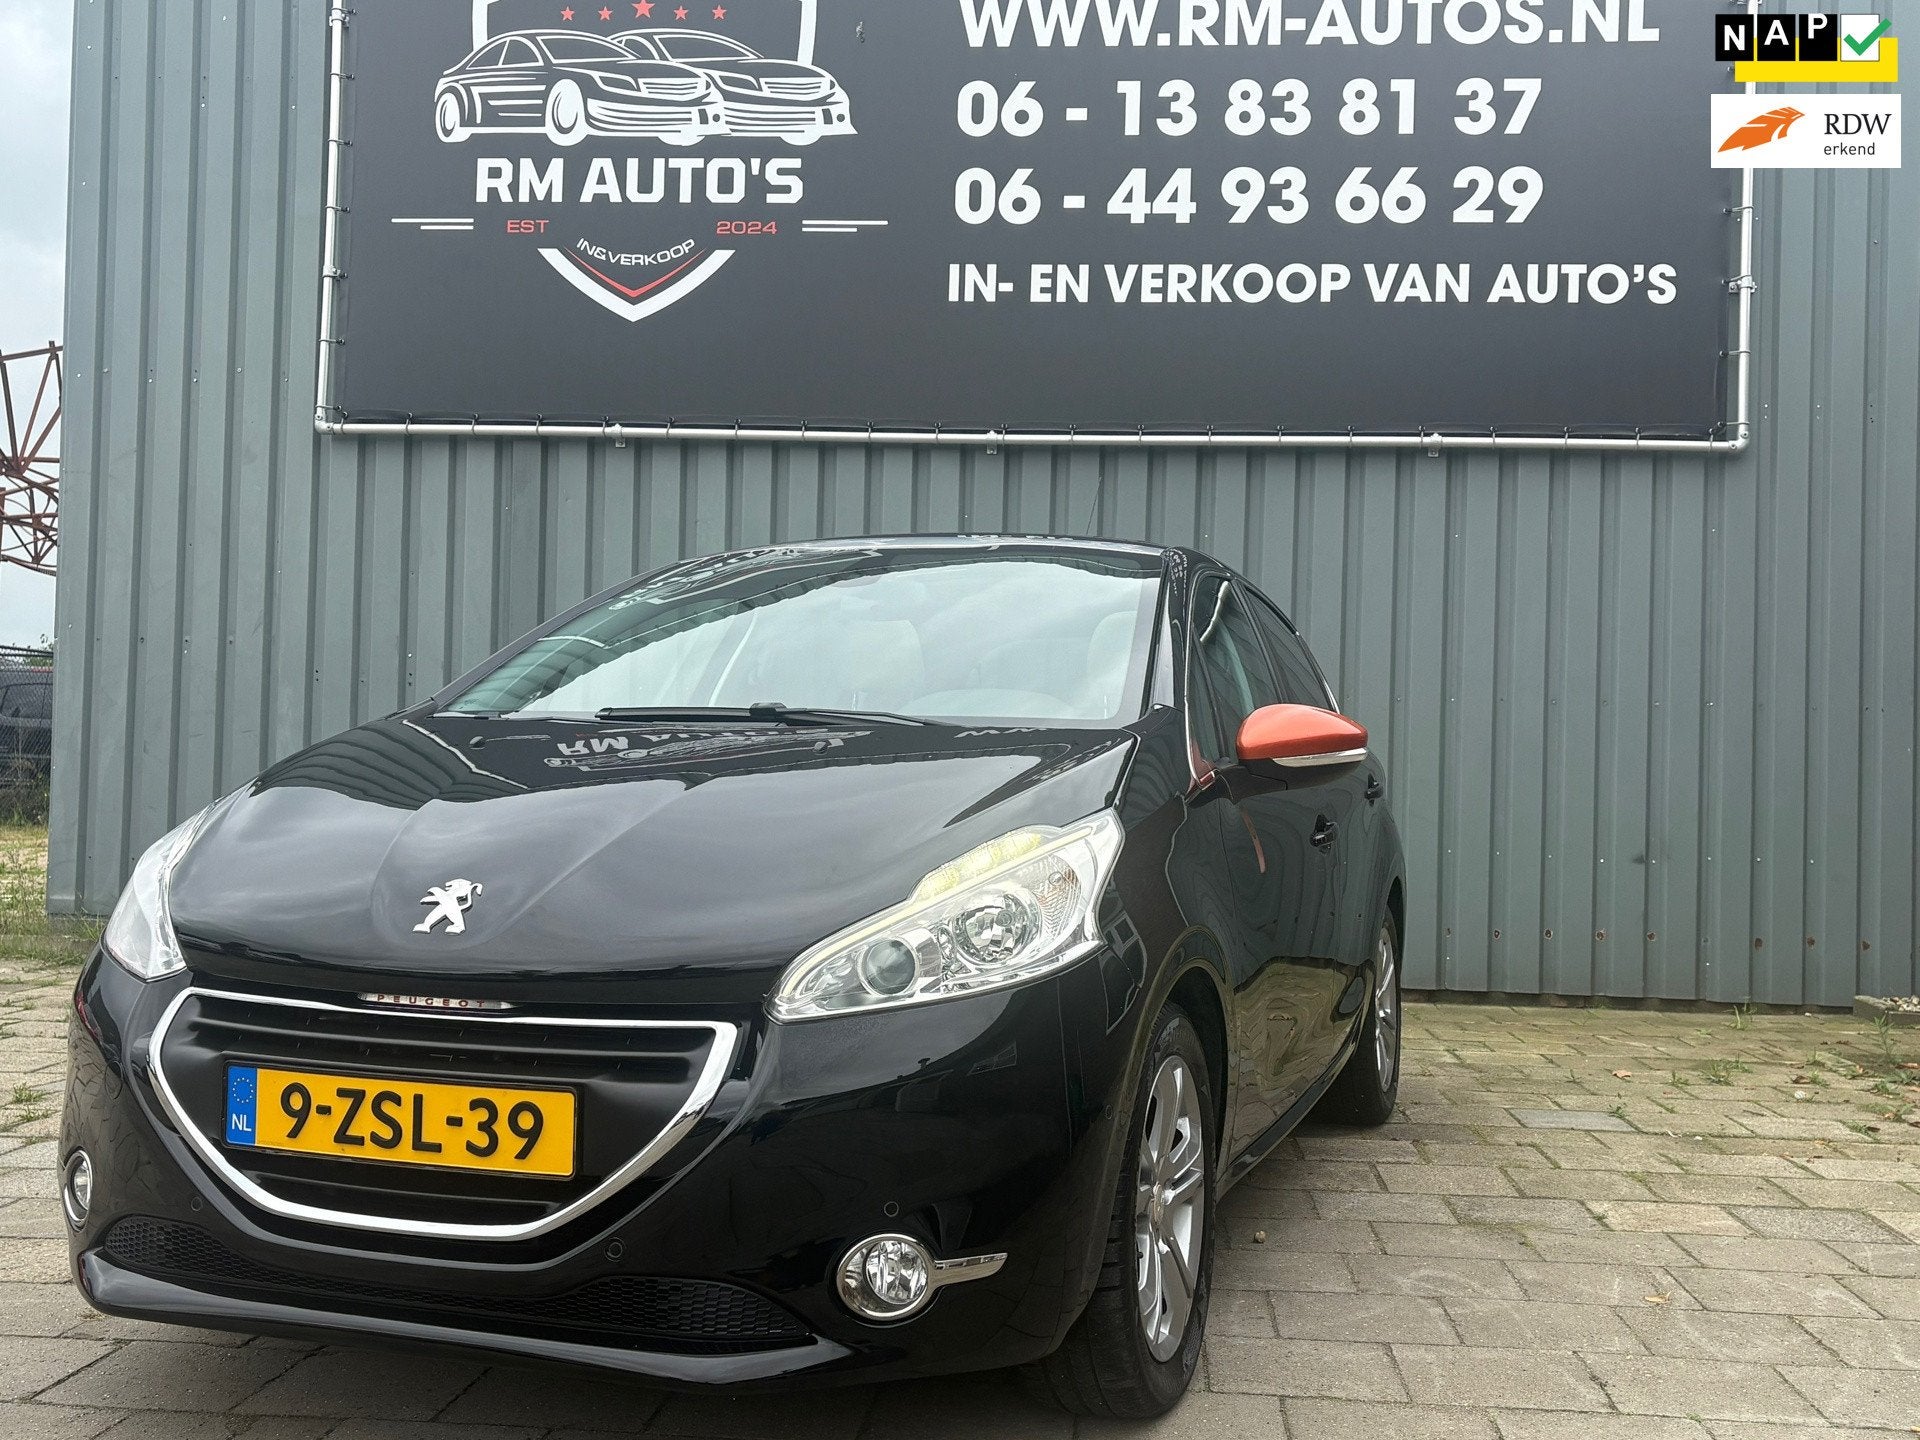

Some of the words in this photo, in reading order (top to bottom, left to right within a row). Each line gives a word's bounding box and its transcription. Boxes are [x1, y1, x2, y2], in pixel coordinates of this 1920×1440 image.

[958, 0, 1660, 48] WWW.RM-AUTOS.NL
[957, 79, 1044, 138] 06
[1065, 107, 1088, 122] -
[1116, 79, 1198, 137] 13
[1224, 78, 1312, 137] 83
[1338, 77, 1416, 136] 81
[1453, 77, 1542, 136] 37
[475, 157, 564, 203] RM
[579, 157, 804, 204] AUTO'S
[954, 167, 1042, 225] 06
[1062, 195, 1086, 209] -
[1106, 167, 1197, 224] 44
[1220, 166, 1309, 225] 93
[1335, 166, 1427, 224] 66
[1452, 165, 1544, 224] 29
[506, 220, 549, 234] EST
[716, 221, 778, 235] 2024
[576, 237, 696, 266] IN&VERKOOP
[948, 263, 1014, 303] IN-
[1029, 263, 1090, 303] EN
[1103, 262, 1351, 304] VERKOOP
[1363, 263, 1470, 303] VAN
[1486, 263, 1677, 305] AUTO'S
[377, 994, 485, 1008] PEUGEOT
[231, 1113, 252, 1132] NL
[280, 1082, 544, 1160] 9-ZSL-39
